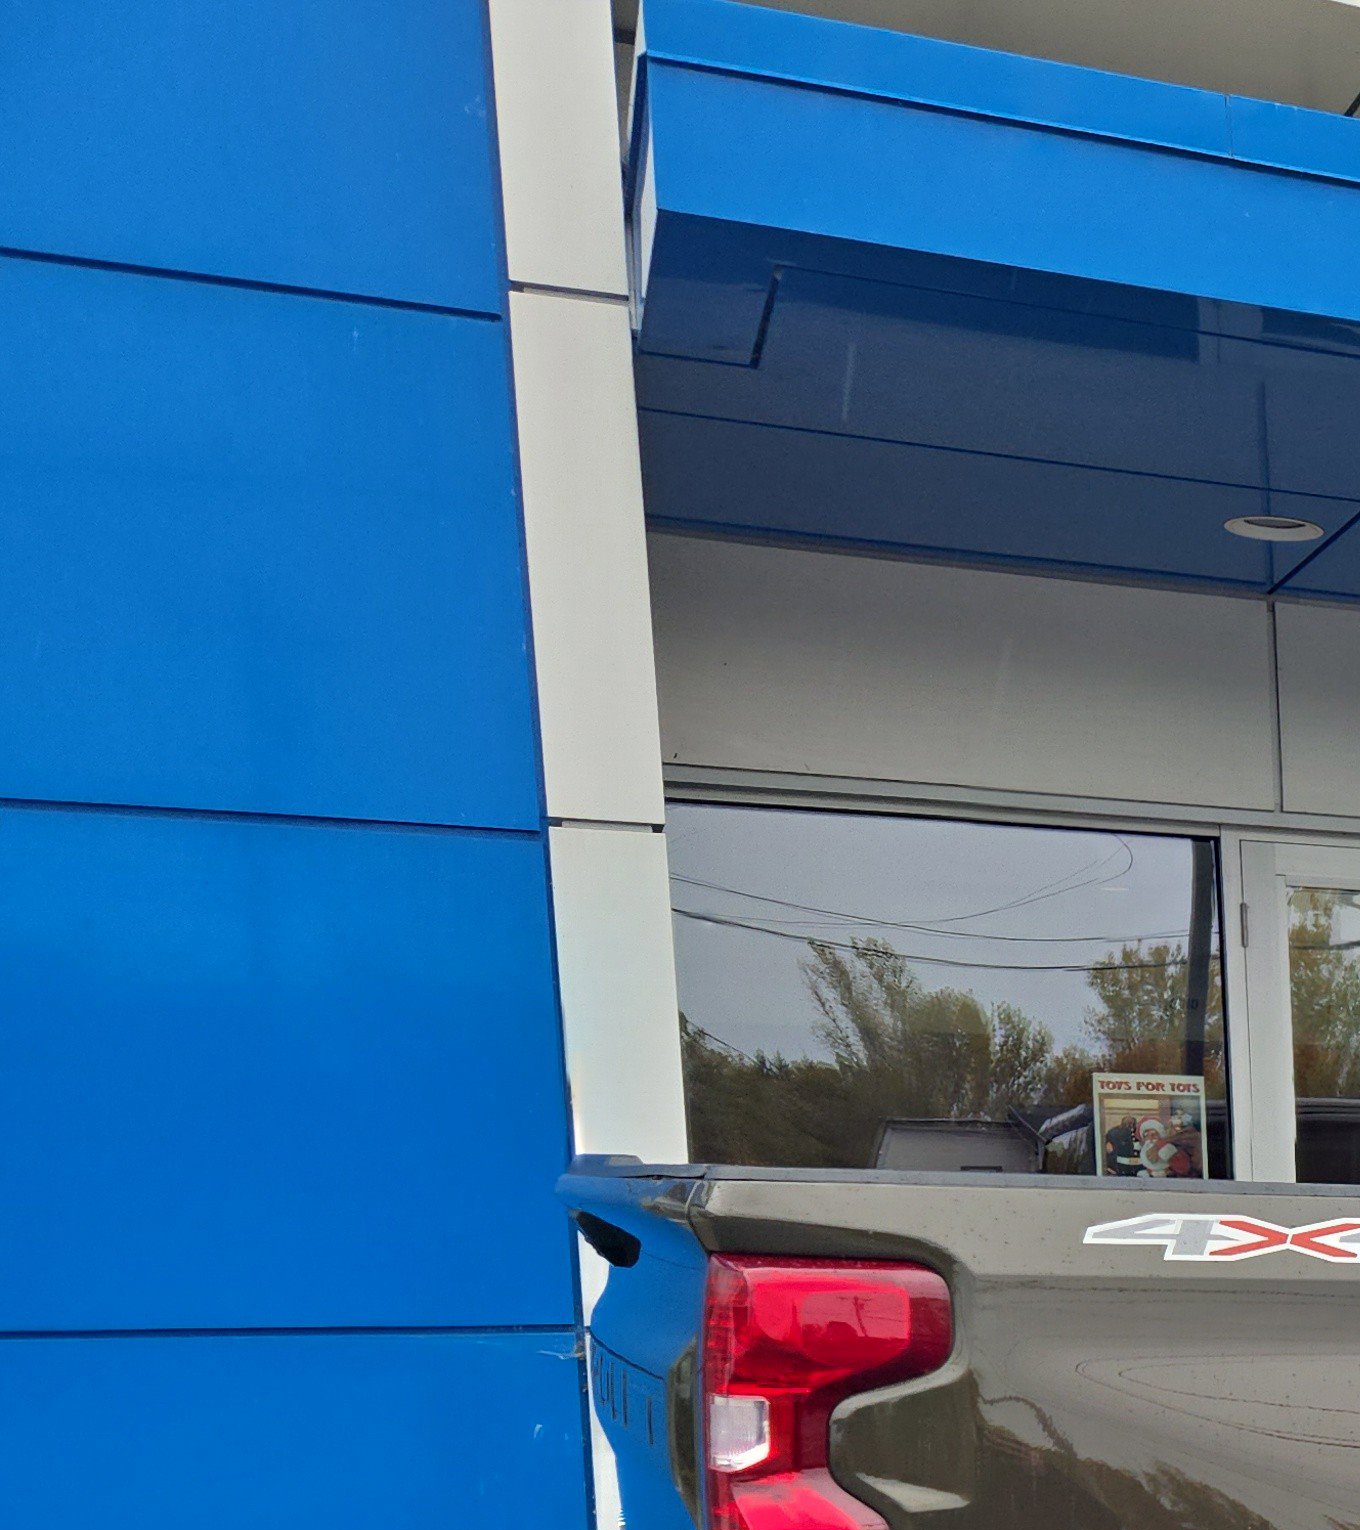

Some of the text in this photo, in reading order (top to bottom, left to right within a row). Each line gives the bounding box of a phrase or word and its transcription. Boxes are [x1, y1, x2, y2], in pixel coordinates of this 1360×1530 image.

[1098, 1080, 1200, 1093] TOYS FOR TOTS
